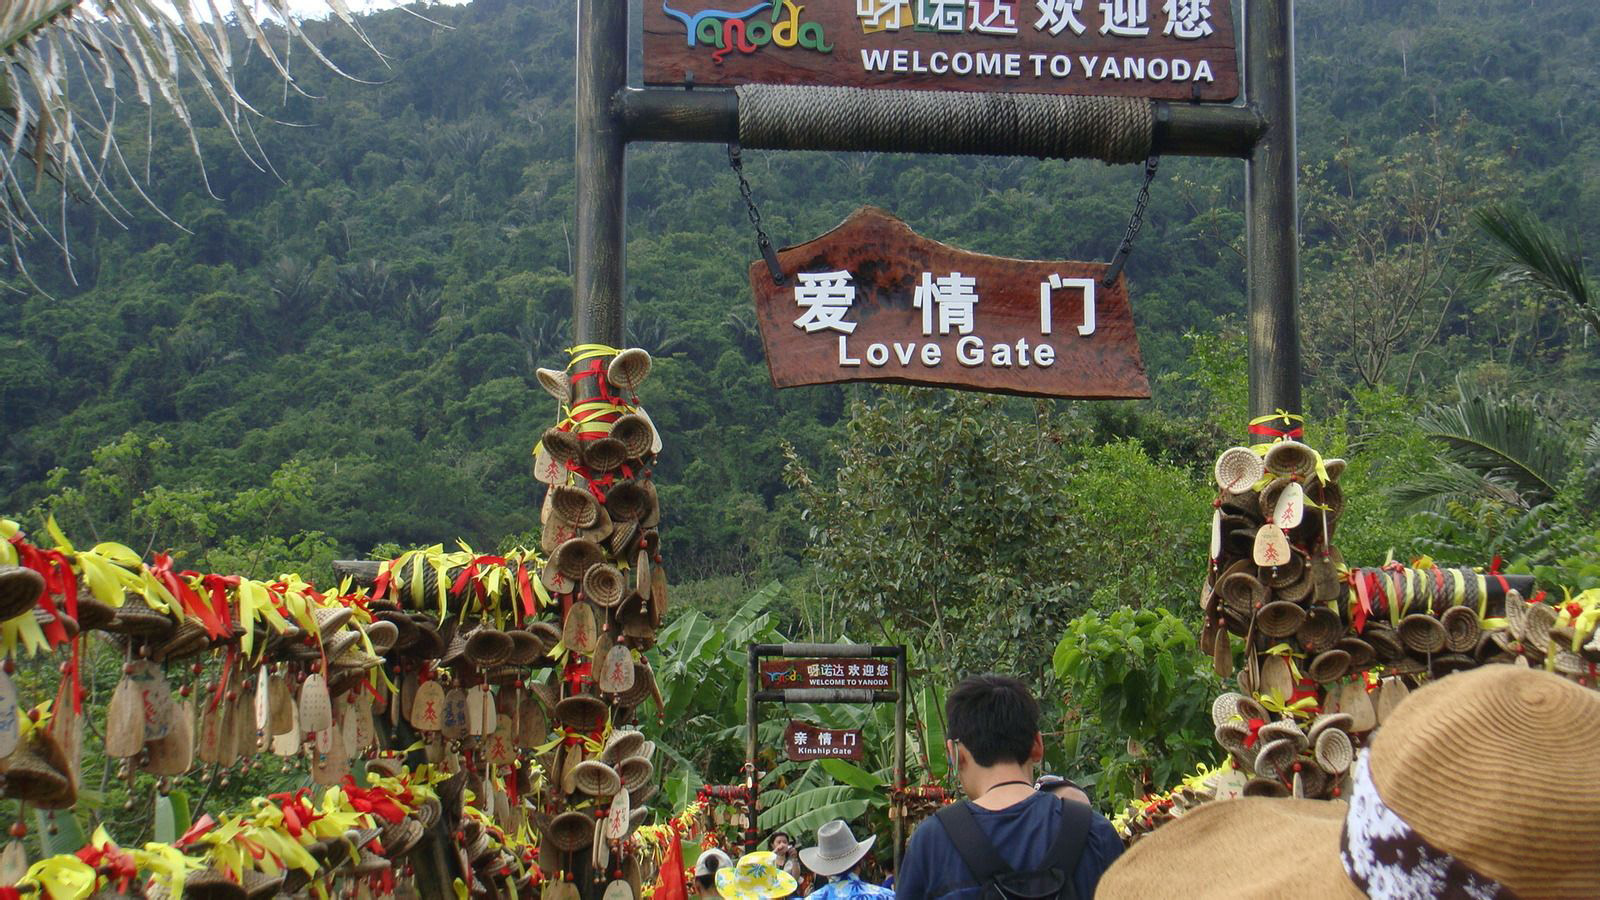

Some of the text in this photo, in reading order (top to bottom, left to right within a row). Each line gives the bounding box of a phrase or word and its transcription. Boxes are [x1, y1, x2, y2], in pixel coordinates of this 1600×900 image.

[861, 49, 1214, 82] WELCOME TO YANODA
[793, 269, 1096, 336] 爱情门
[838, 335, 1055, 368] Love Gate
[807, 664, 888, 676] 呀诺达 欢迎您
[794, 732, 855, 746] 亲情门
[798, 747, 852, 755] Kinship Gate
